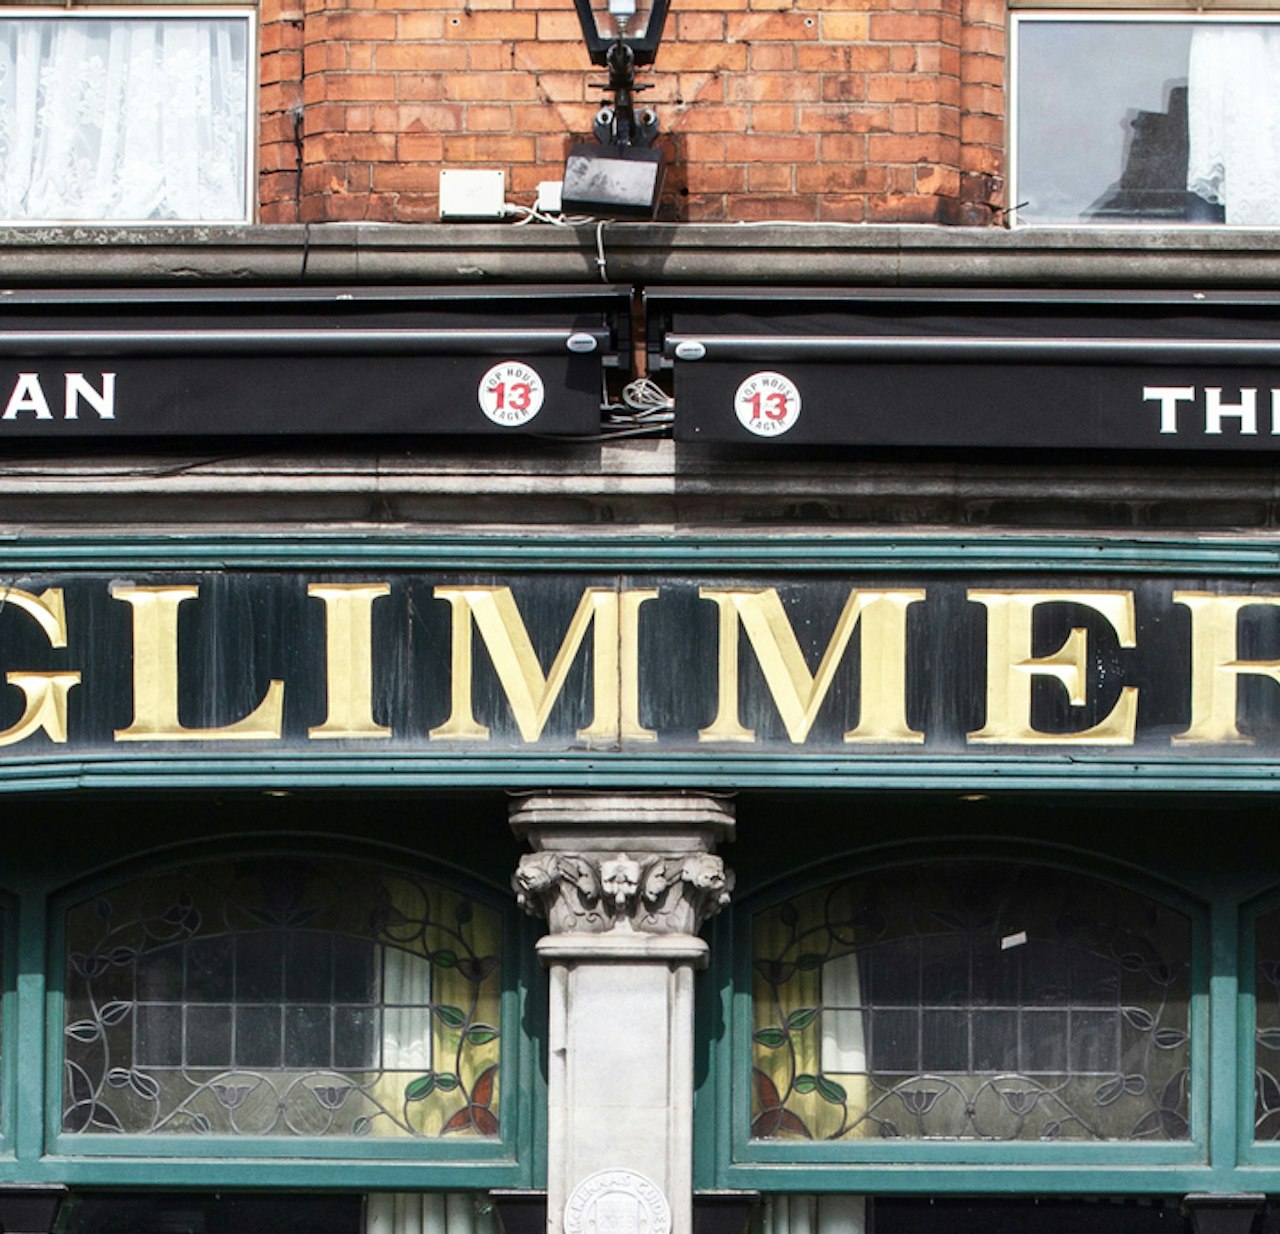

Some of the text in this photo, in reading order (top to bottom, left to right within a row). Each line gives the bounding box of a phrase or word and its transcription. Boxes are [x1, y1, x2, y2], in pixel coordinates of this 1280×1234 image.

[486, 368, 539, 393] HOP HOUSE
[742, 379, 795, 404] HOP HOUSE
[488, 382, 532, 410] 13
[745, 393, 789, 420] 13
[492, 408, 530, 421] LAGER
[749, 418, 785, 431] LAGER
